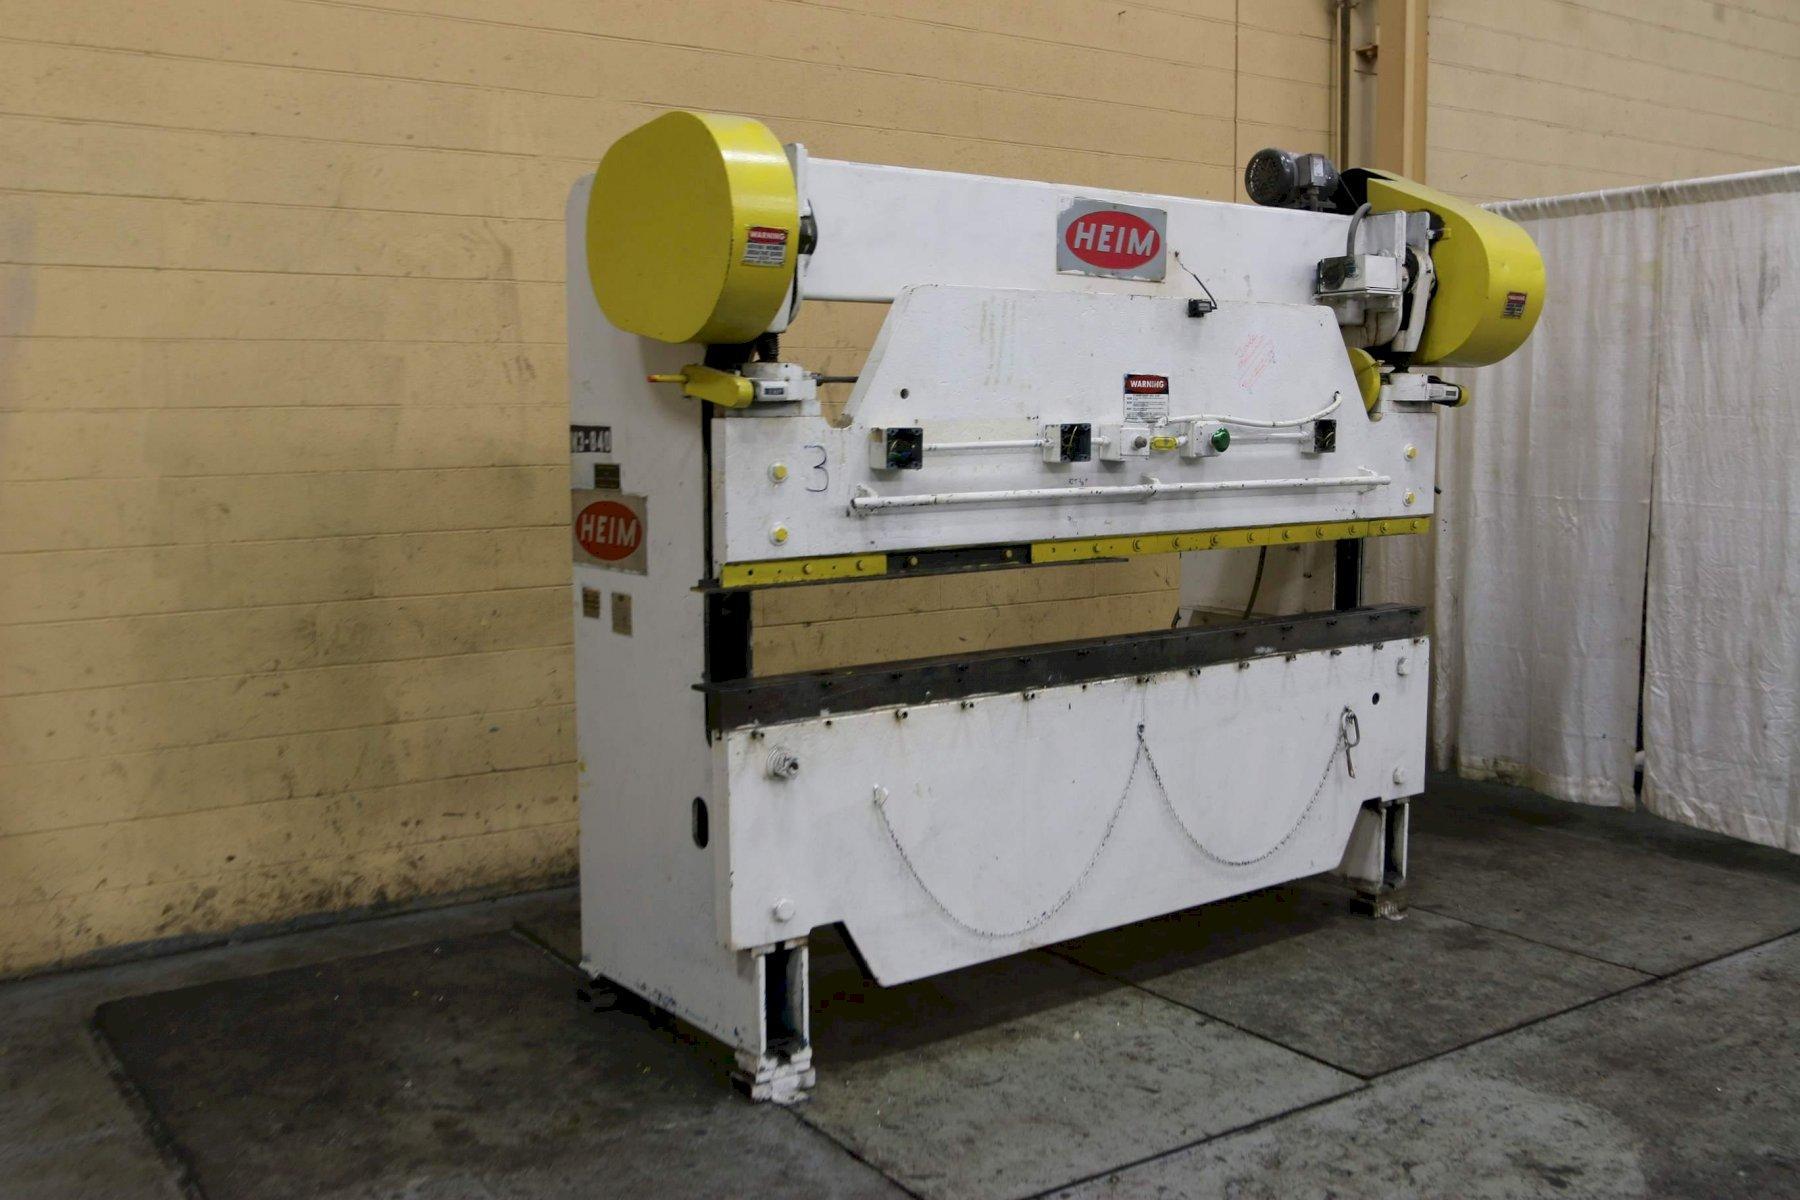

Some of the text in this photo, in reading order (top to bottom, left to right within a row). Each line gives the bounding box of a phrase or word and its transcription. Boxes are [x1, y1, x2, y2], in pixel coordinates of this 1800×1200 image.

[750, 230, 786, 241] WARNING
[1074, 222, 1155, 256] HEIM
[1130, 380, 1164, 389] WARNING
[803, 444, 829, 493] 3
[580, 514, 638, 547] HEIM
